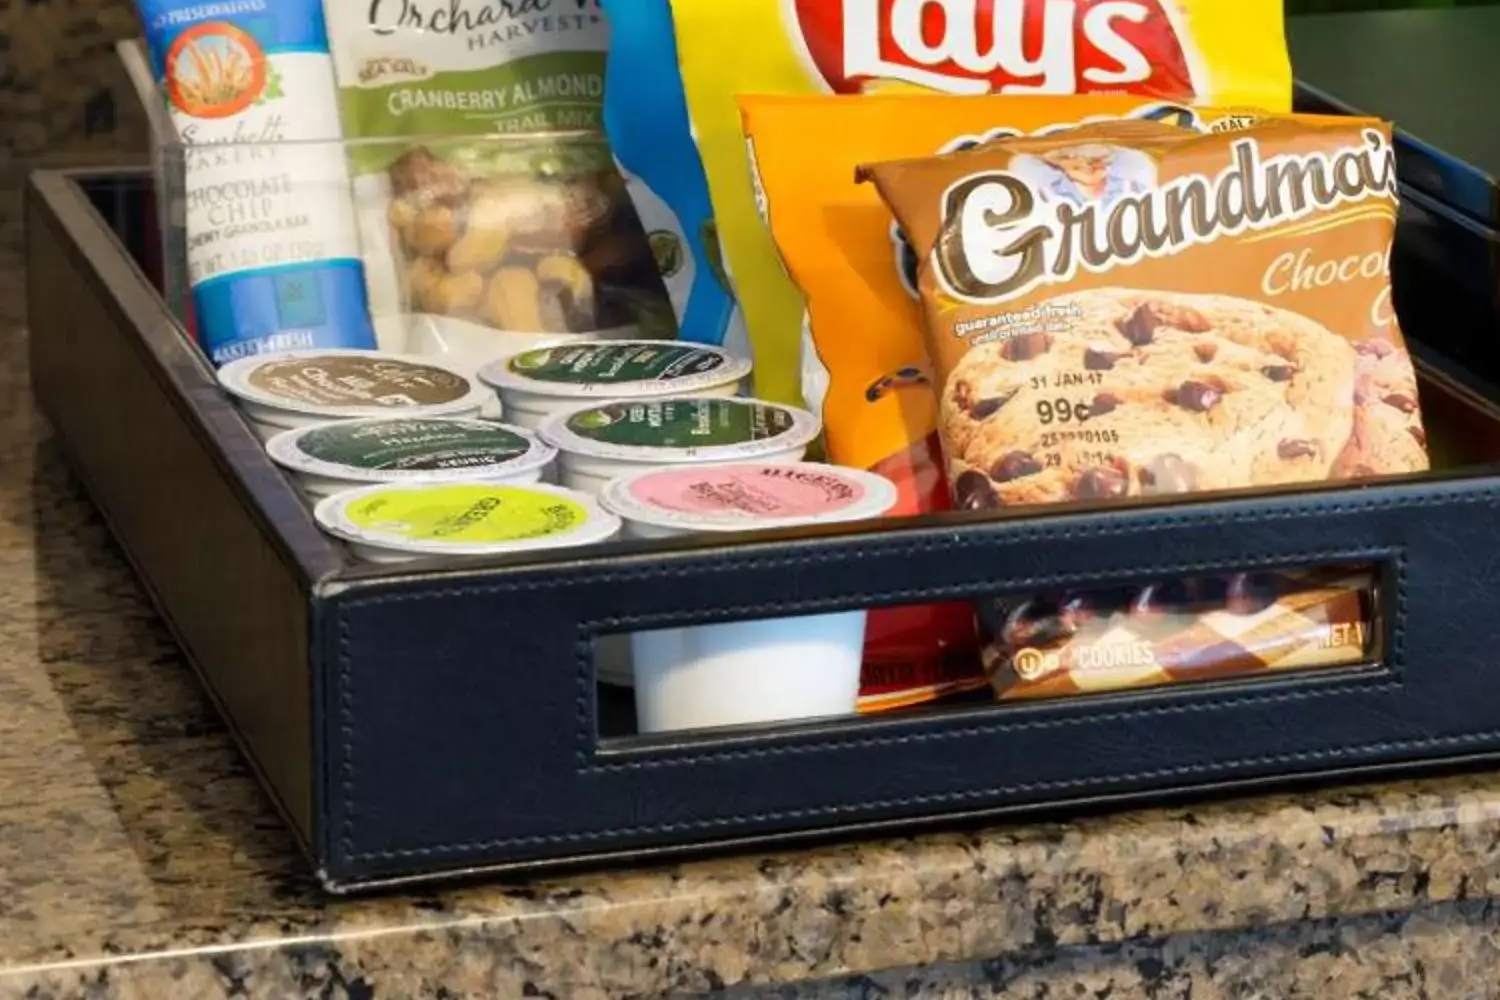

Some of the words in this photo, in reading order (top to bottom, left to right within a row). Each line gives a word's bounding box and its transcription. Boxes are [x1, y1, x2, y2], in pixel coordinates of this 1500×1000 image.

[466, 14, 586, 50] HARVEST
[387, 88, 506, 116] CRANBERRY
[512, 73, 602, 104] ALMOND
[494, 113, 550, 132] TRAIL
[556, 110, 596, 127] MIX
[208, 198, 273, 227] CHIP
[955, 307, 1041, 336] guaranteed
[1030, 376, 1048, 390] 31
[1054, 373, 1083, 388] JAN
[1036, 397, 1090, 424] 99¢
[1078, 641, 1156, 668] COOKIES
